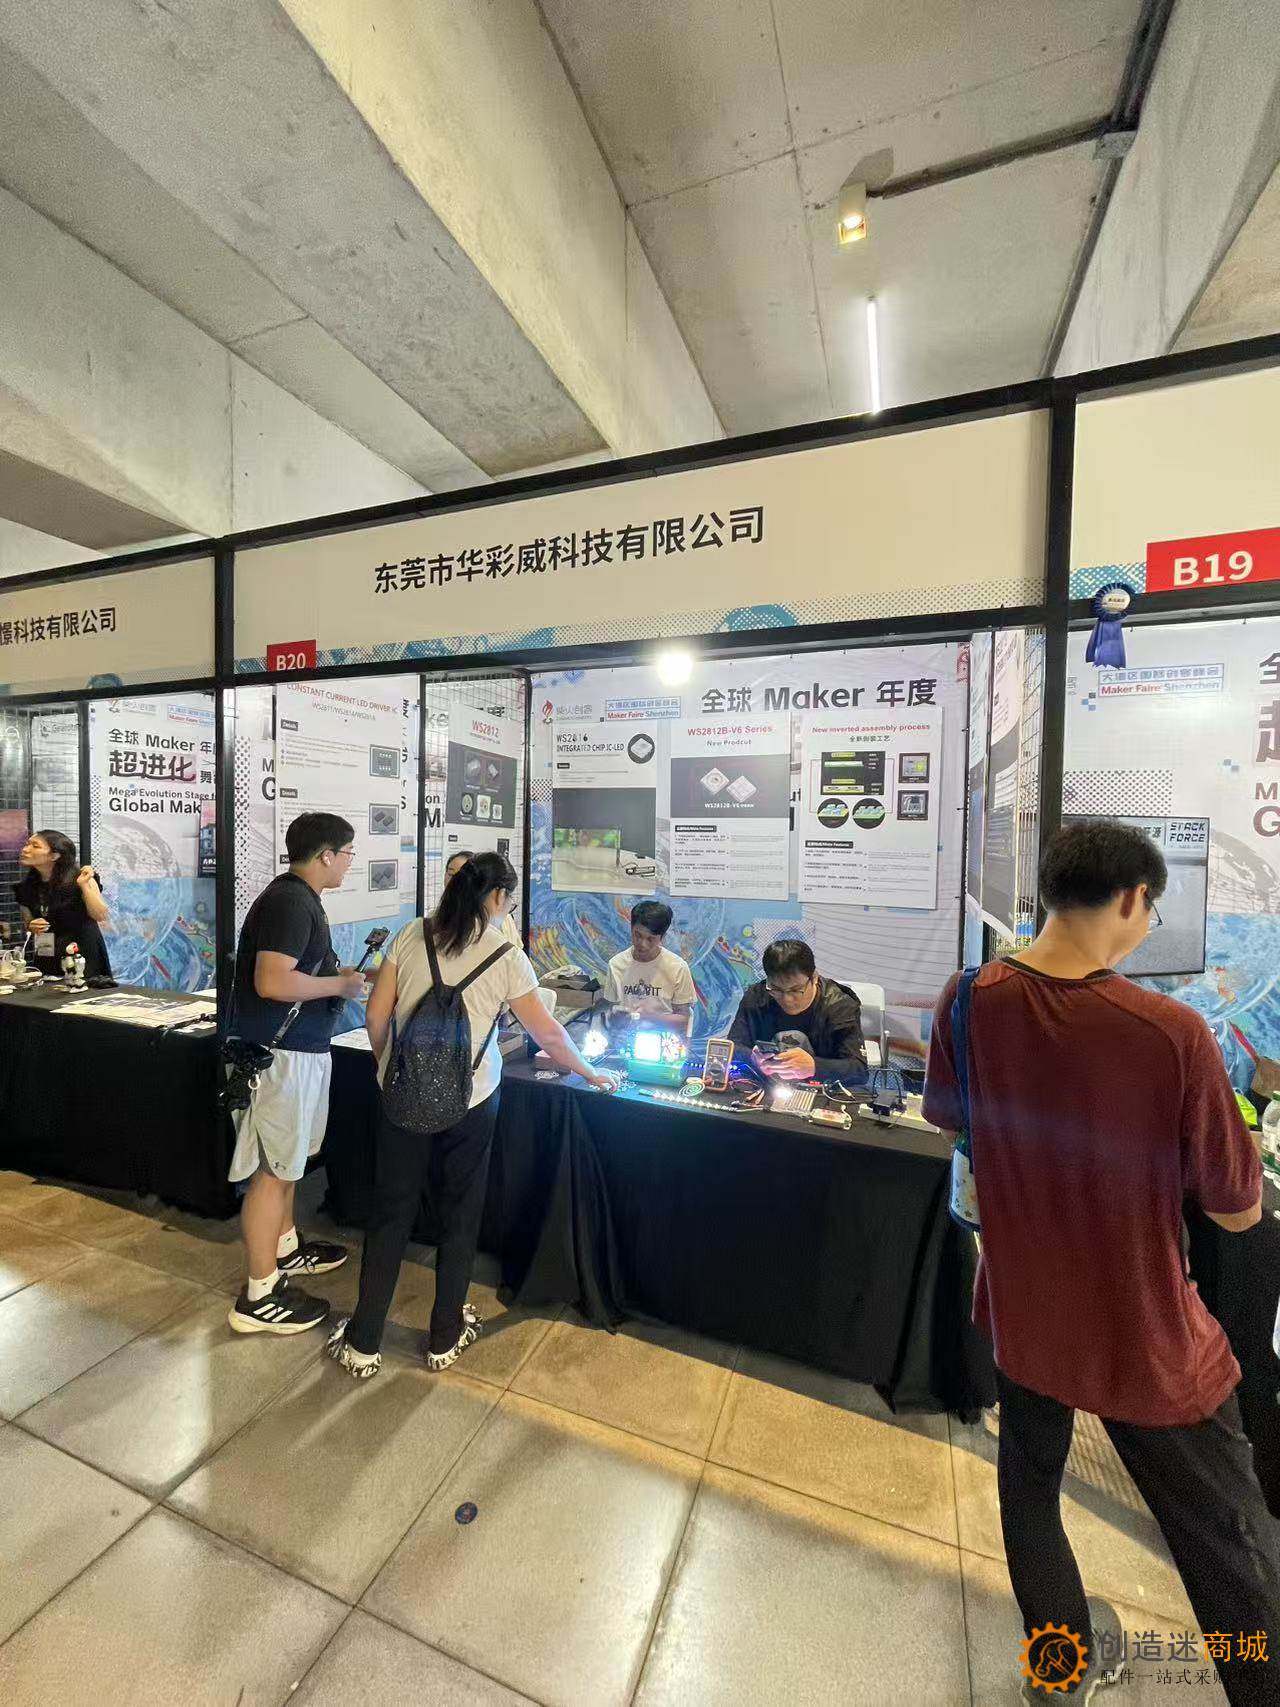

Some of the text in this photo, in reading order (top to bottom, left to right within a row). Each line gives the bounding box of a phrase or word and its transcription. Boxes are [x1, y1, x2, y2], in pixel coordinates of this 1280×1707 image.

[374, 506, 764, 594] 东莞市华彩威科技有限公司
[1173, 551, 1254, 587] B19
[276, 653, 306, 671] B20
[701, 678, 937, 713] 全球 Maker 年度
[1101, 681, 1219, 695] Maker Faire Shenzhen
[287, 683, 325, 697] CONSTANT
[326, 691, 356, 704] CURRENT
[356, 699, 368, 708] LED
[369, 702, 391, 712] DRIVER
[607, 711, 627, 719] Maker
[472, 720, 500, 738] WS2812
[687, 727, 742, 736] WS2812B-V6
[109, 728, 139, 745] 全球
[146, 734, 195, 751] Maker
[556, 744, 591, 752] INTEGRATED
[109, 750, 196, 781] 超进化
[109, 787, 136, 797] Mega
[139, 788, 182, 798] Evolution
[185, 791, 210, 800] Stage
[109, 798, 201, 813] Global Mak
[1170, 822, 1205, 831] STACK
[1169, 834, 1205, 842] FORCE
